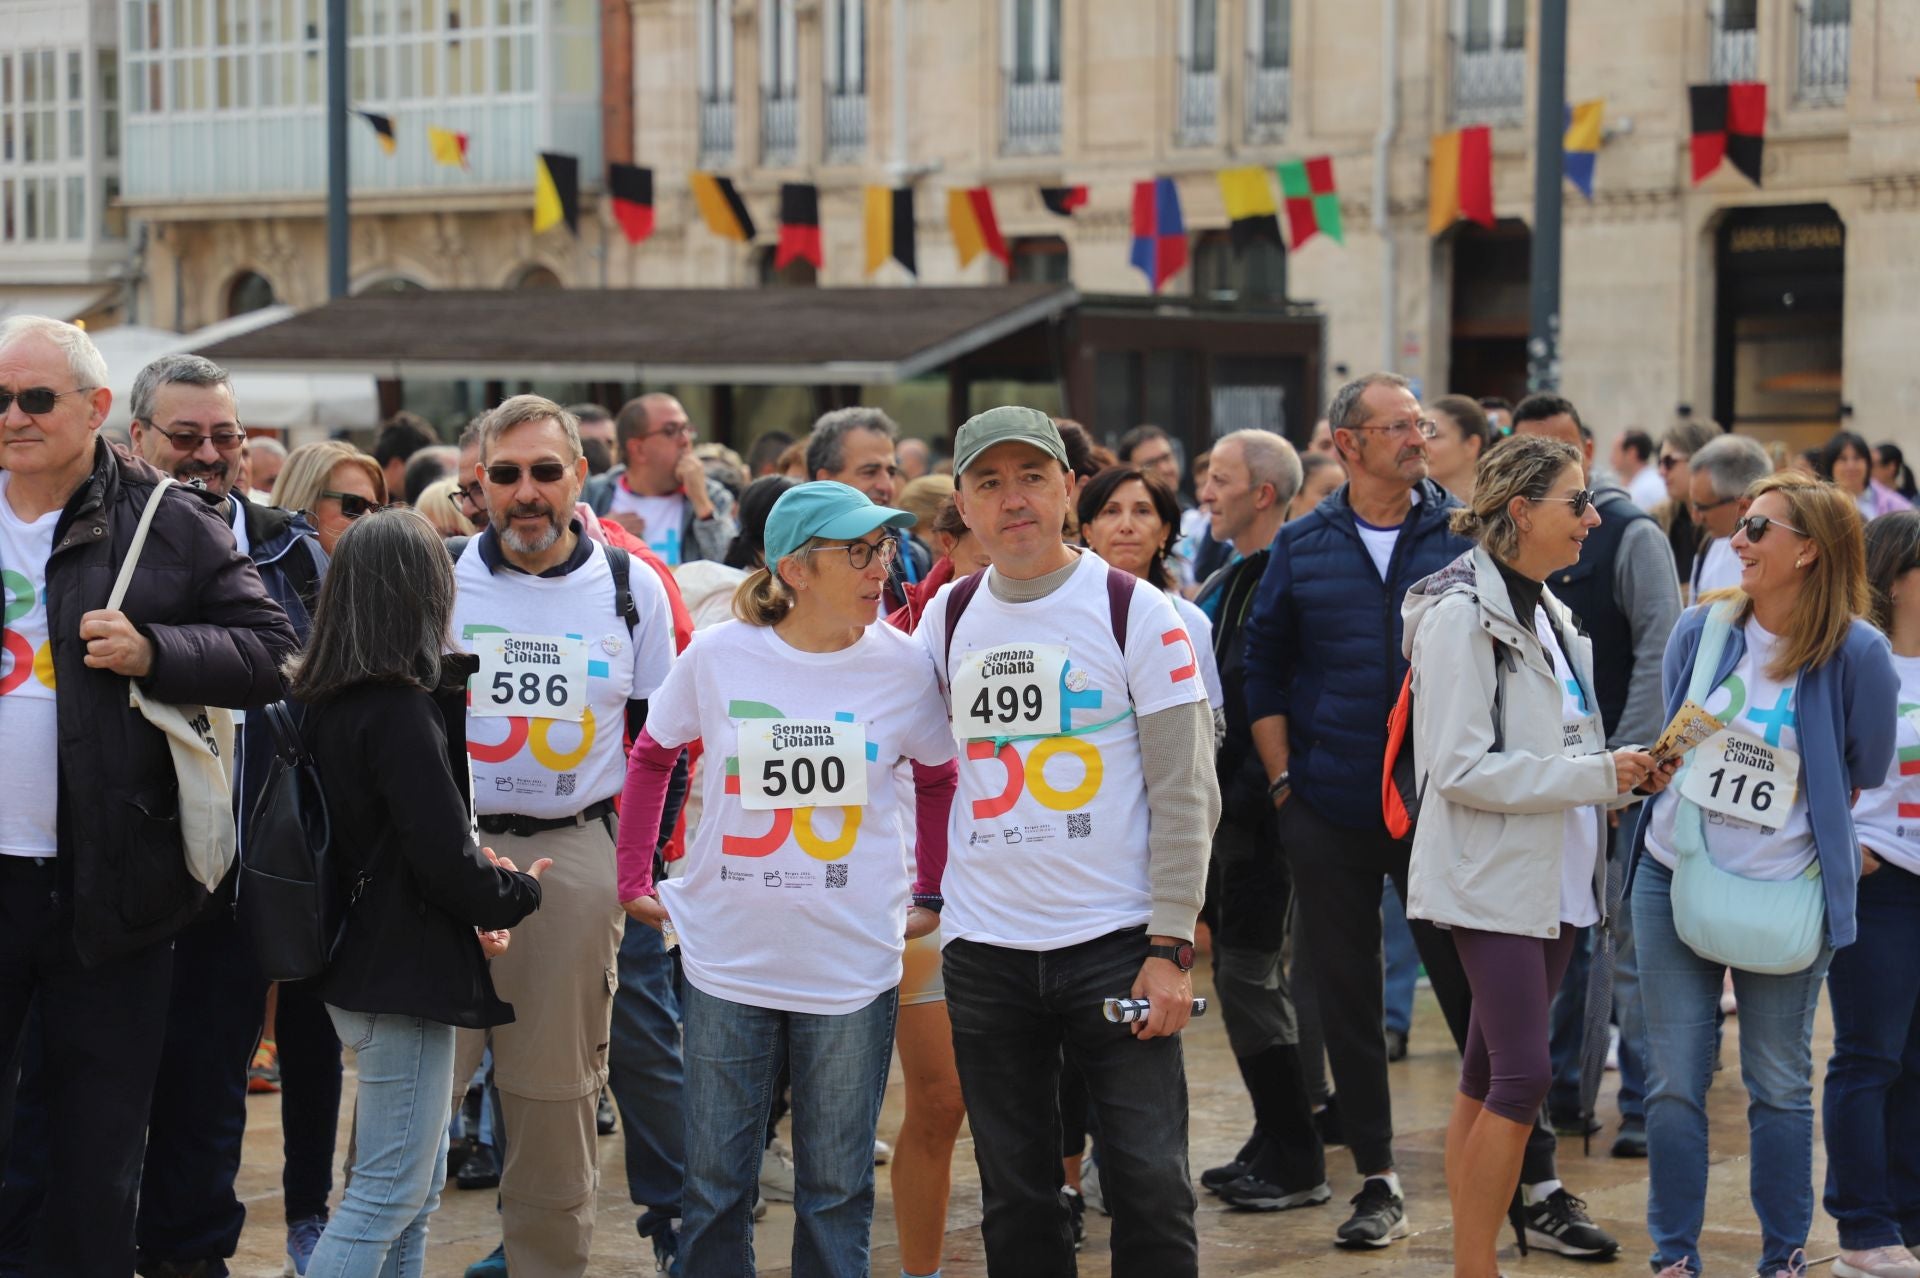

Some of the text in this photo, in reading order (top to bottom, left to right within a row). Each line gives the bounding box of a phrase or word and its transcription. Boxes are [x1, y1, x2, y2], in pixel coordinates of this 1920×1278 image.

[504, 638, 558, 652] Semana
[503, 650, 561, 665] Cidiana
[984, 649, 1034, 664] Semana
[981, 661, 1035, 679] Cidiana
[490, 671, 569, 706] 586
[970, 684, 1043, 724] 499
[772, 723, 831, 737] Semana
[772, 734, 835, 751] Cidiana
[1726, 736, 1774, 760] Semana
[1724, 748, 1775, 772] Cidiana
[762, 756, 845, 796] 500
[1709, 768, 1775, 811] 116
